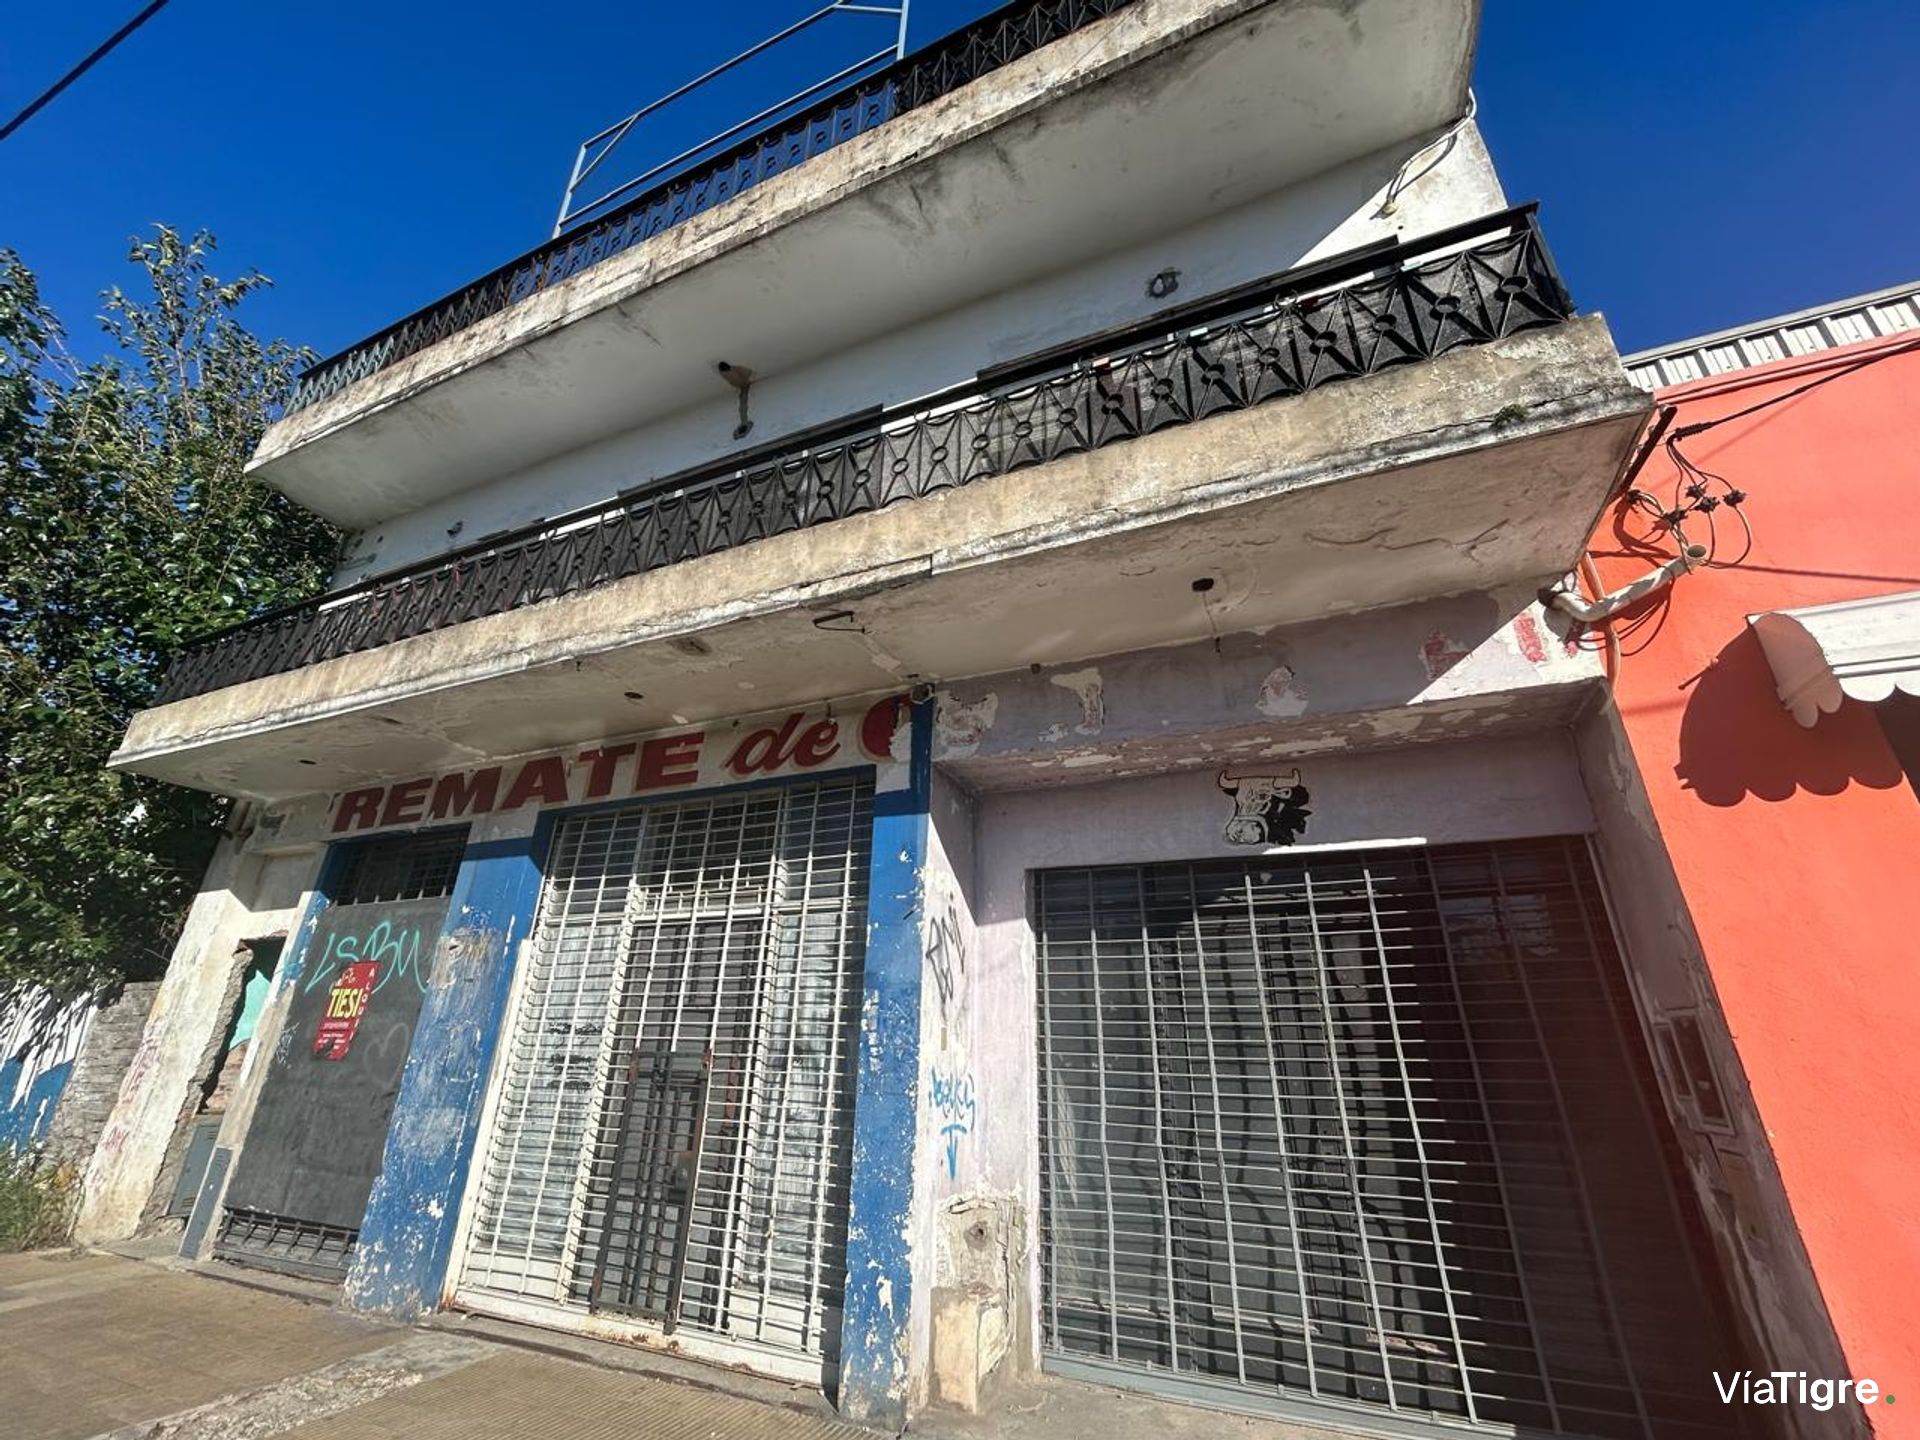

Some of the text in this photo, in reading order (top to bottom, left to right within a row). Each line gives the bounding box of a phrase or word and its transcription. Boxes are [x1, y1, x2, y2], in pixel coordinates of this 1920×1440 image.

[332, 732, 705, 833] REMATE
[725, 711, 841, 767] de
[326, 988, 364, 1018] TIESI
